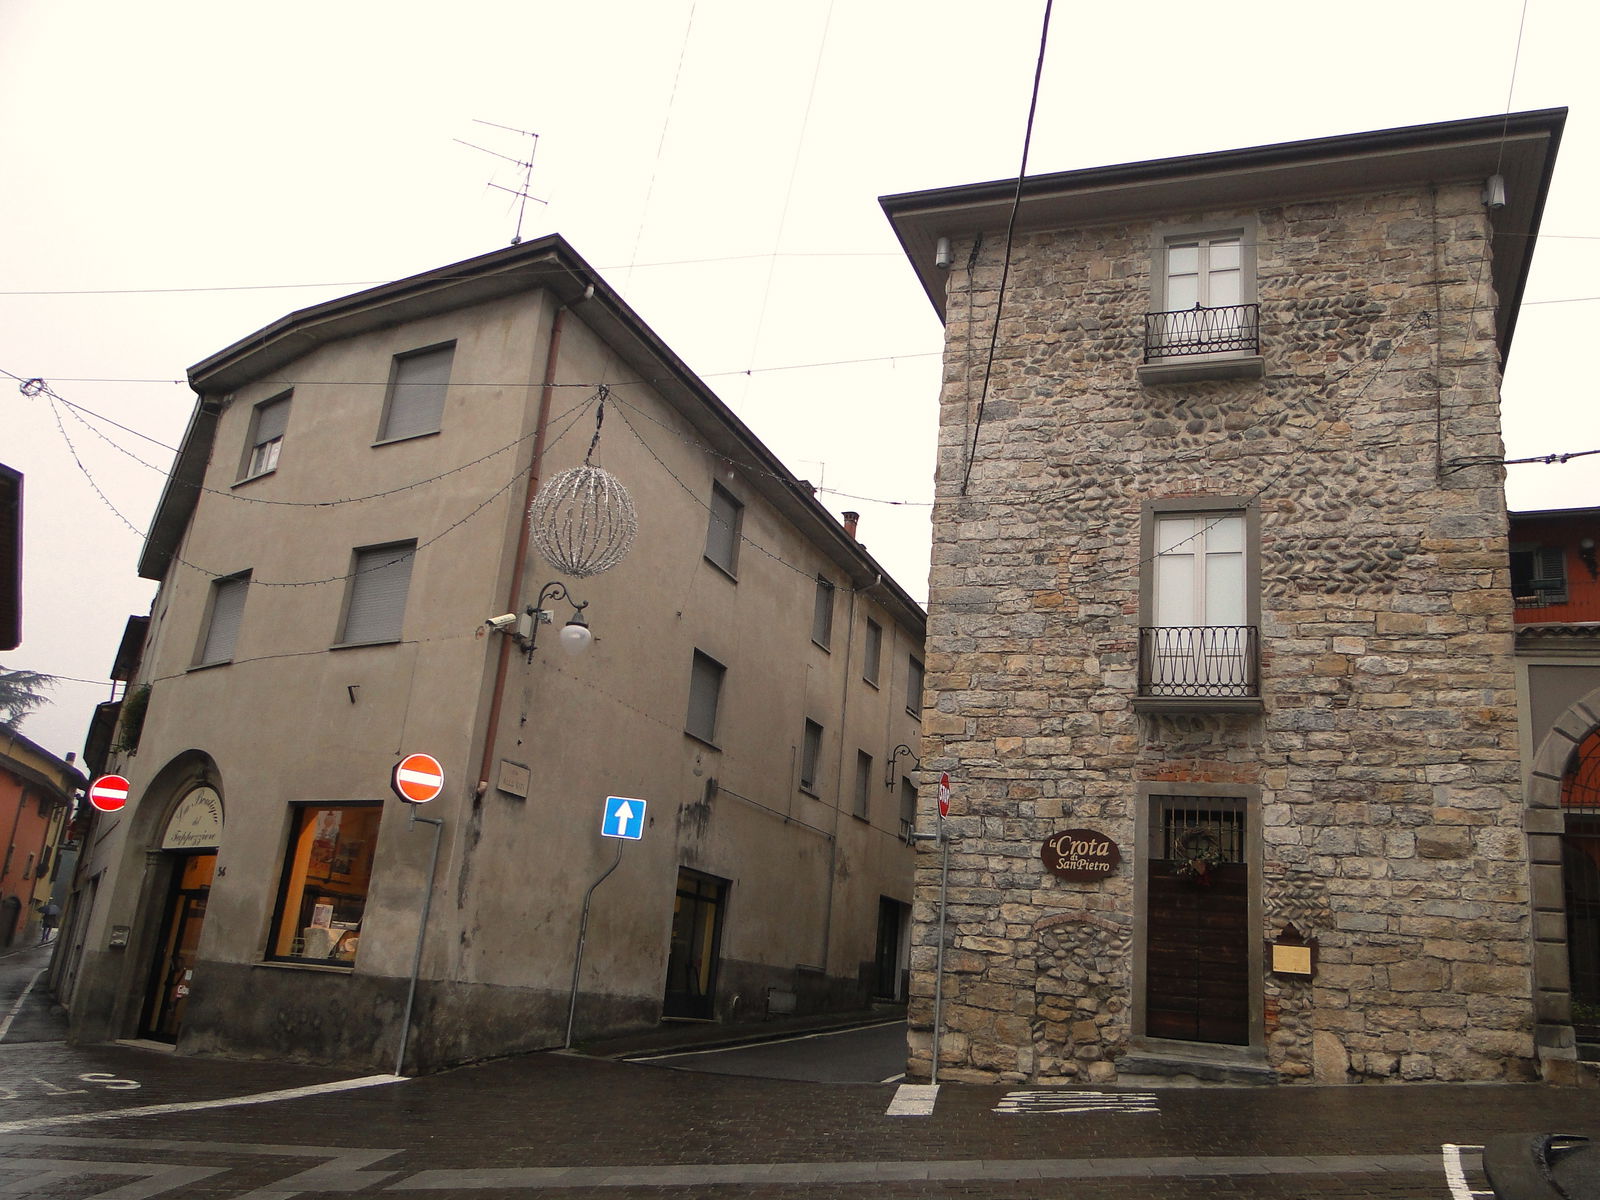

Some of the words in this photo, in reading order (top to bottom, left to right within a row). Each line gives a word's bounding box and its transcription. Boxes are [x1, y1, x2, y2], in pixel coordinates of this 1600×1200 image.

[940, 783, 950, 805] STOP
[1056, 835, 1110, 857] Crota
[1070, 852, 1079, 861] di
[1077, 858, 1111, 872] Pietro
